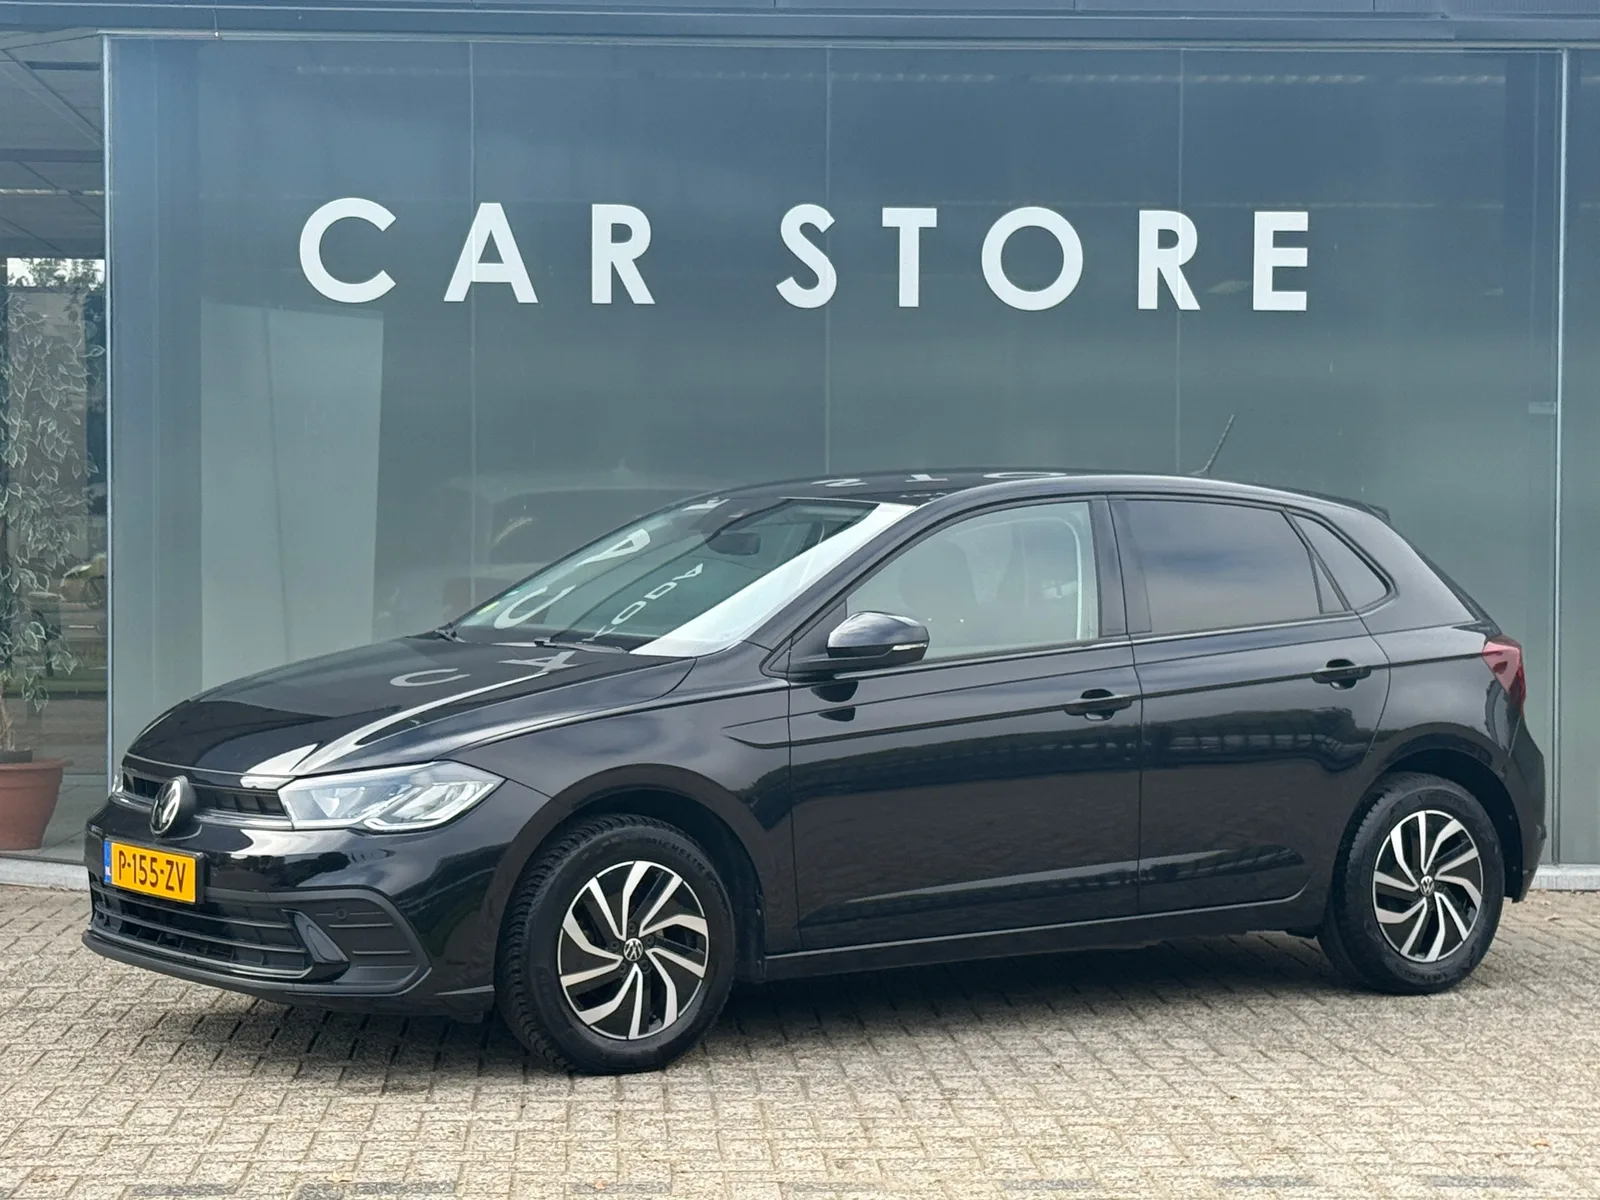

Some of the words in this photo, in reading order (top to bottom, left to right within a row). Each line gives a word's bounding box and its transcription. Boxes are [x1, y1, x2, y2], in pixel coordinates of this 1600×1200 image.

[299, 197, 654, 304] CAR
[777, 204, 1309, 312] STORE
[118, 850, 186, 893] P-155-ZV
